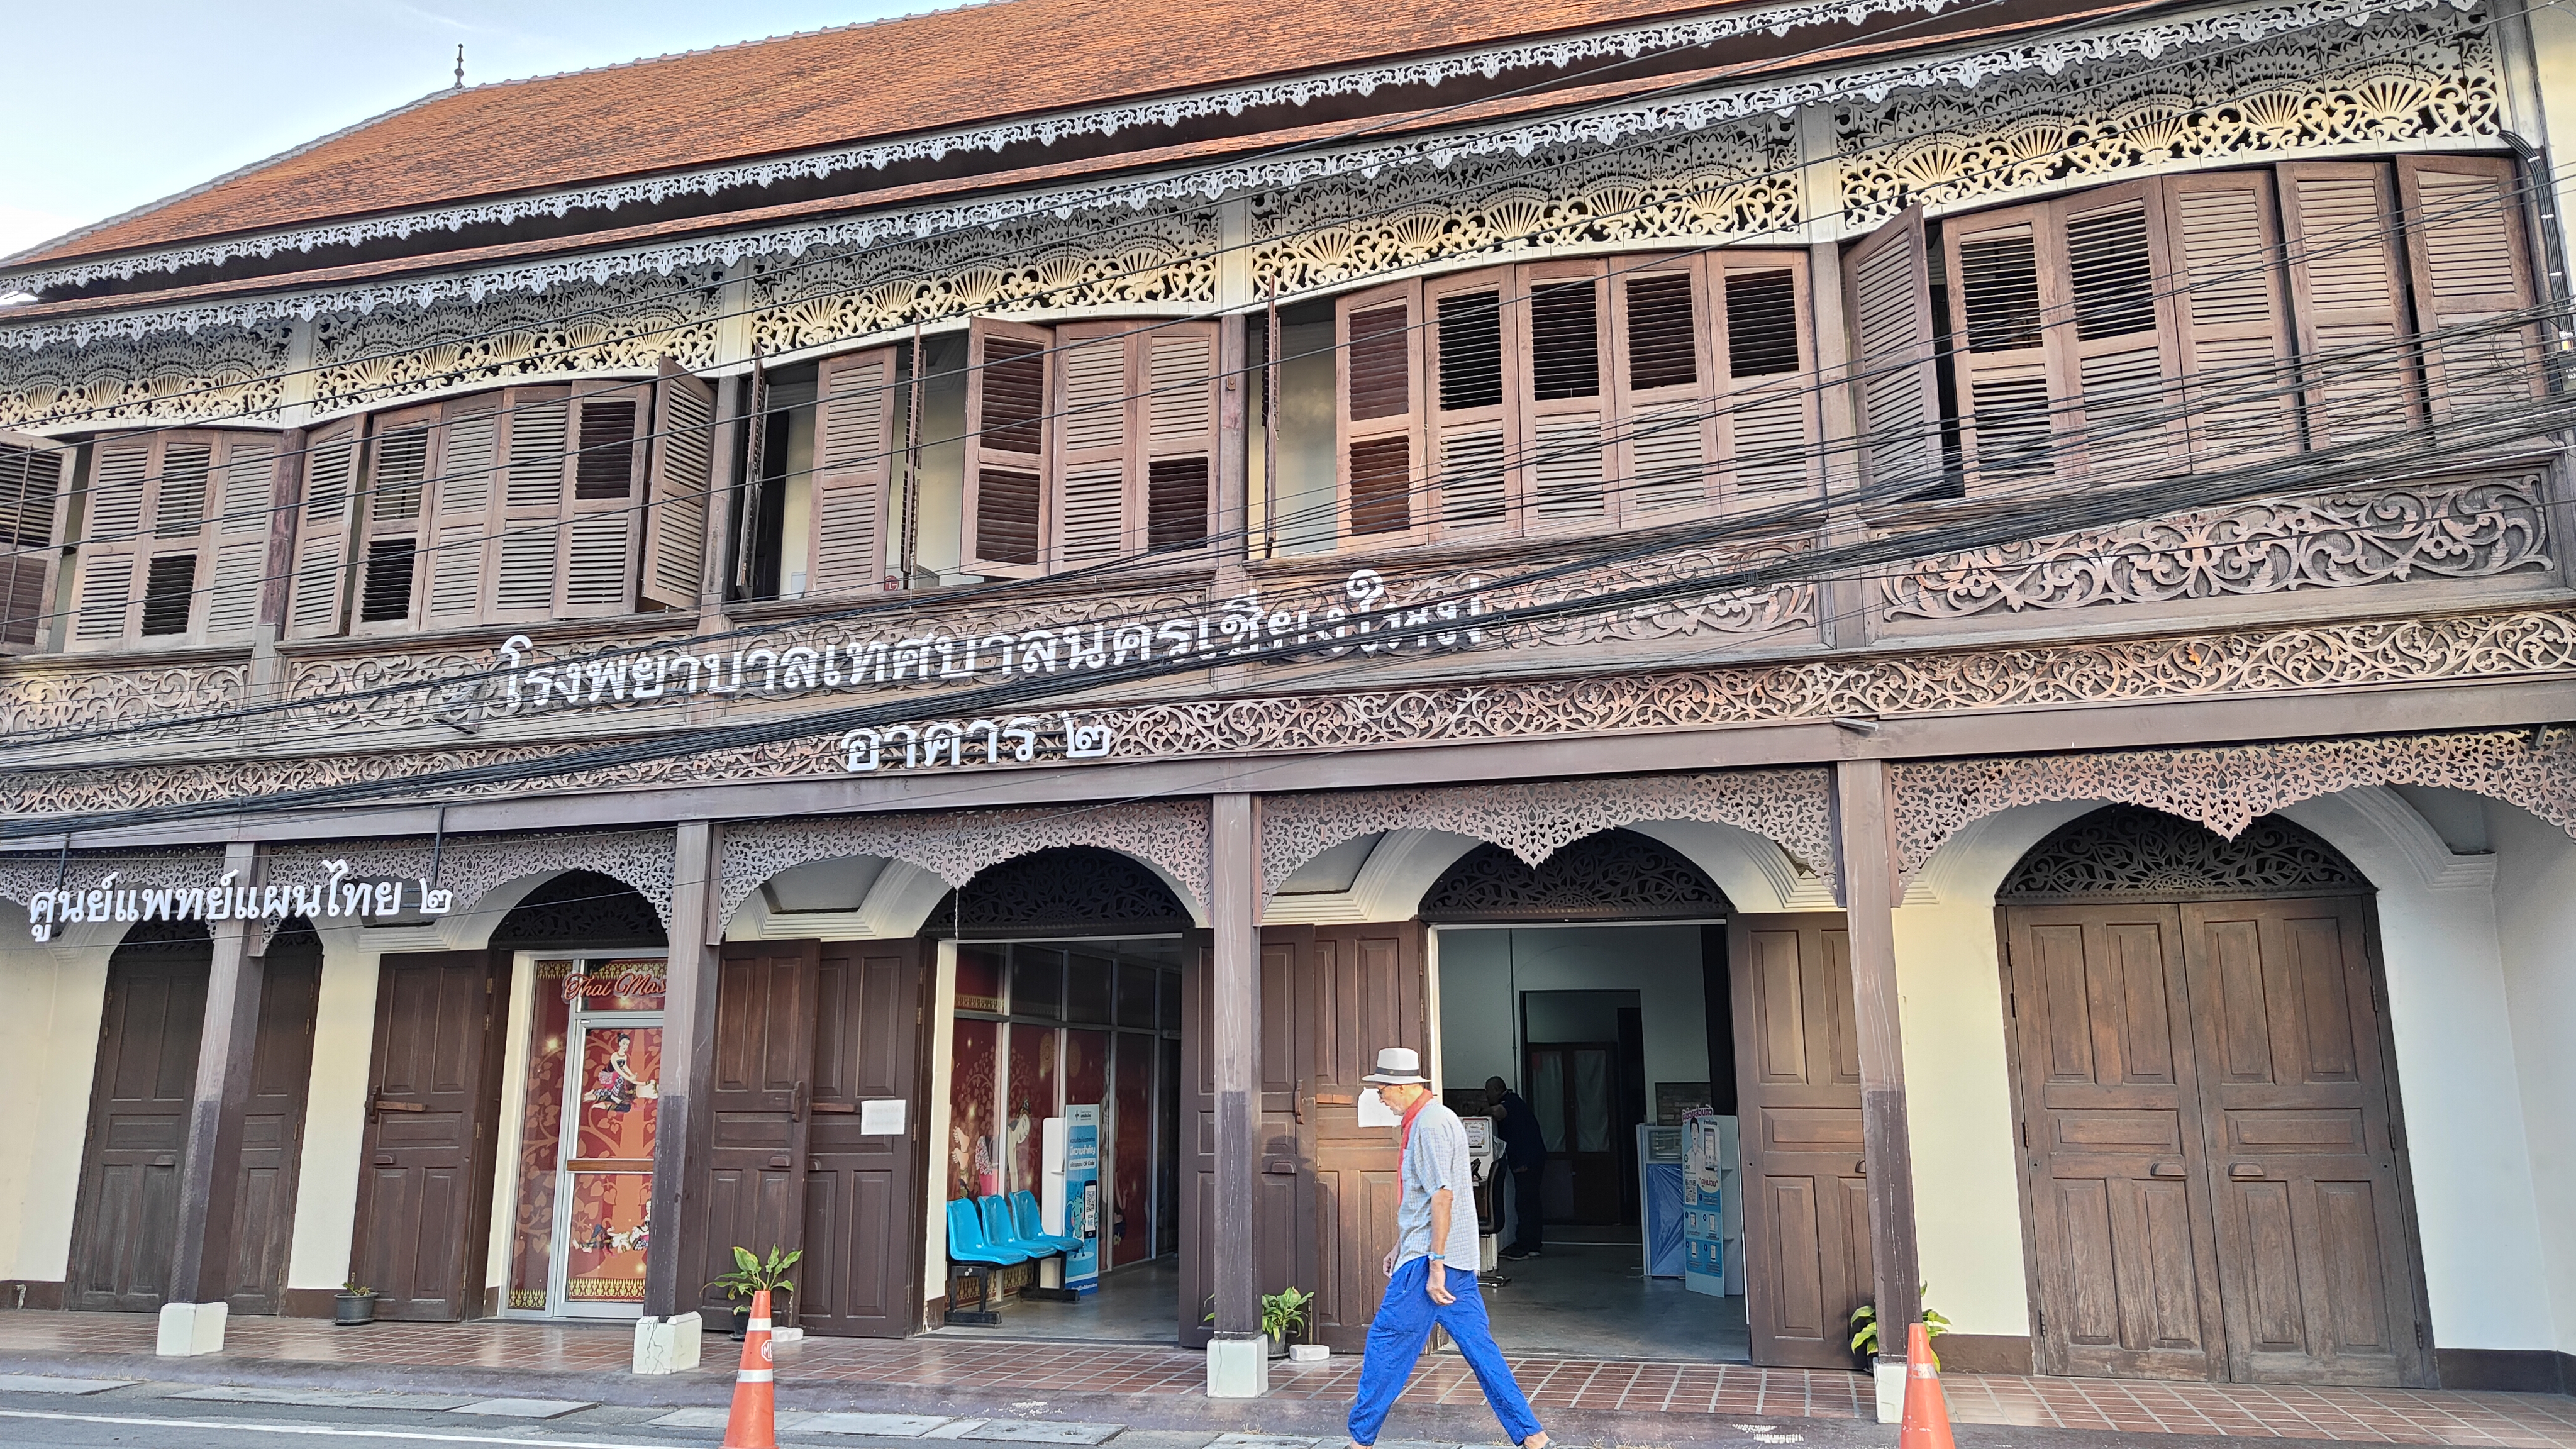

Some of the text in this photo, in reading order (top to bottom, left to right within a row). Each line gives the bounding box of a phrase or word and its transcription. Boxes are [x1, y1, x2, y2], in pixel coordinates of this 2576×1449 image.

[840, 709, 1112, 773] อาคาร ๒
[28, 858, 453, 943] ศูนย์แพทย์แผนไทย ๒
[564, 972, 667, 1000] Thai Mas
